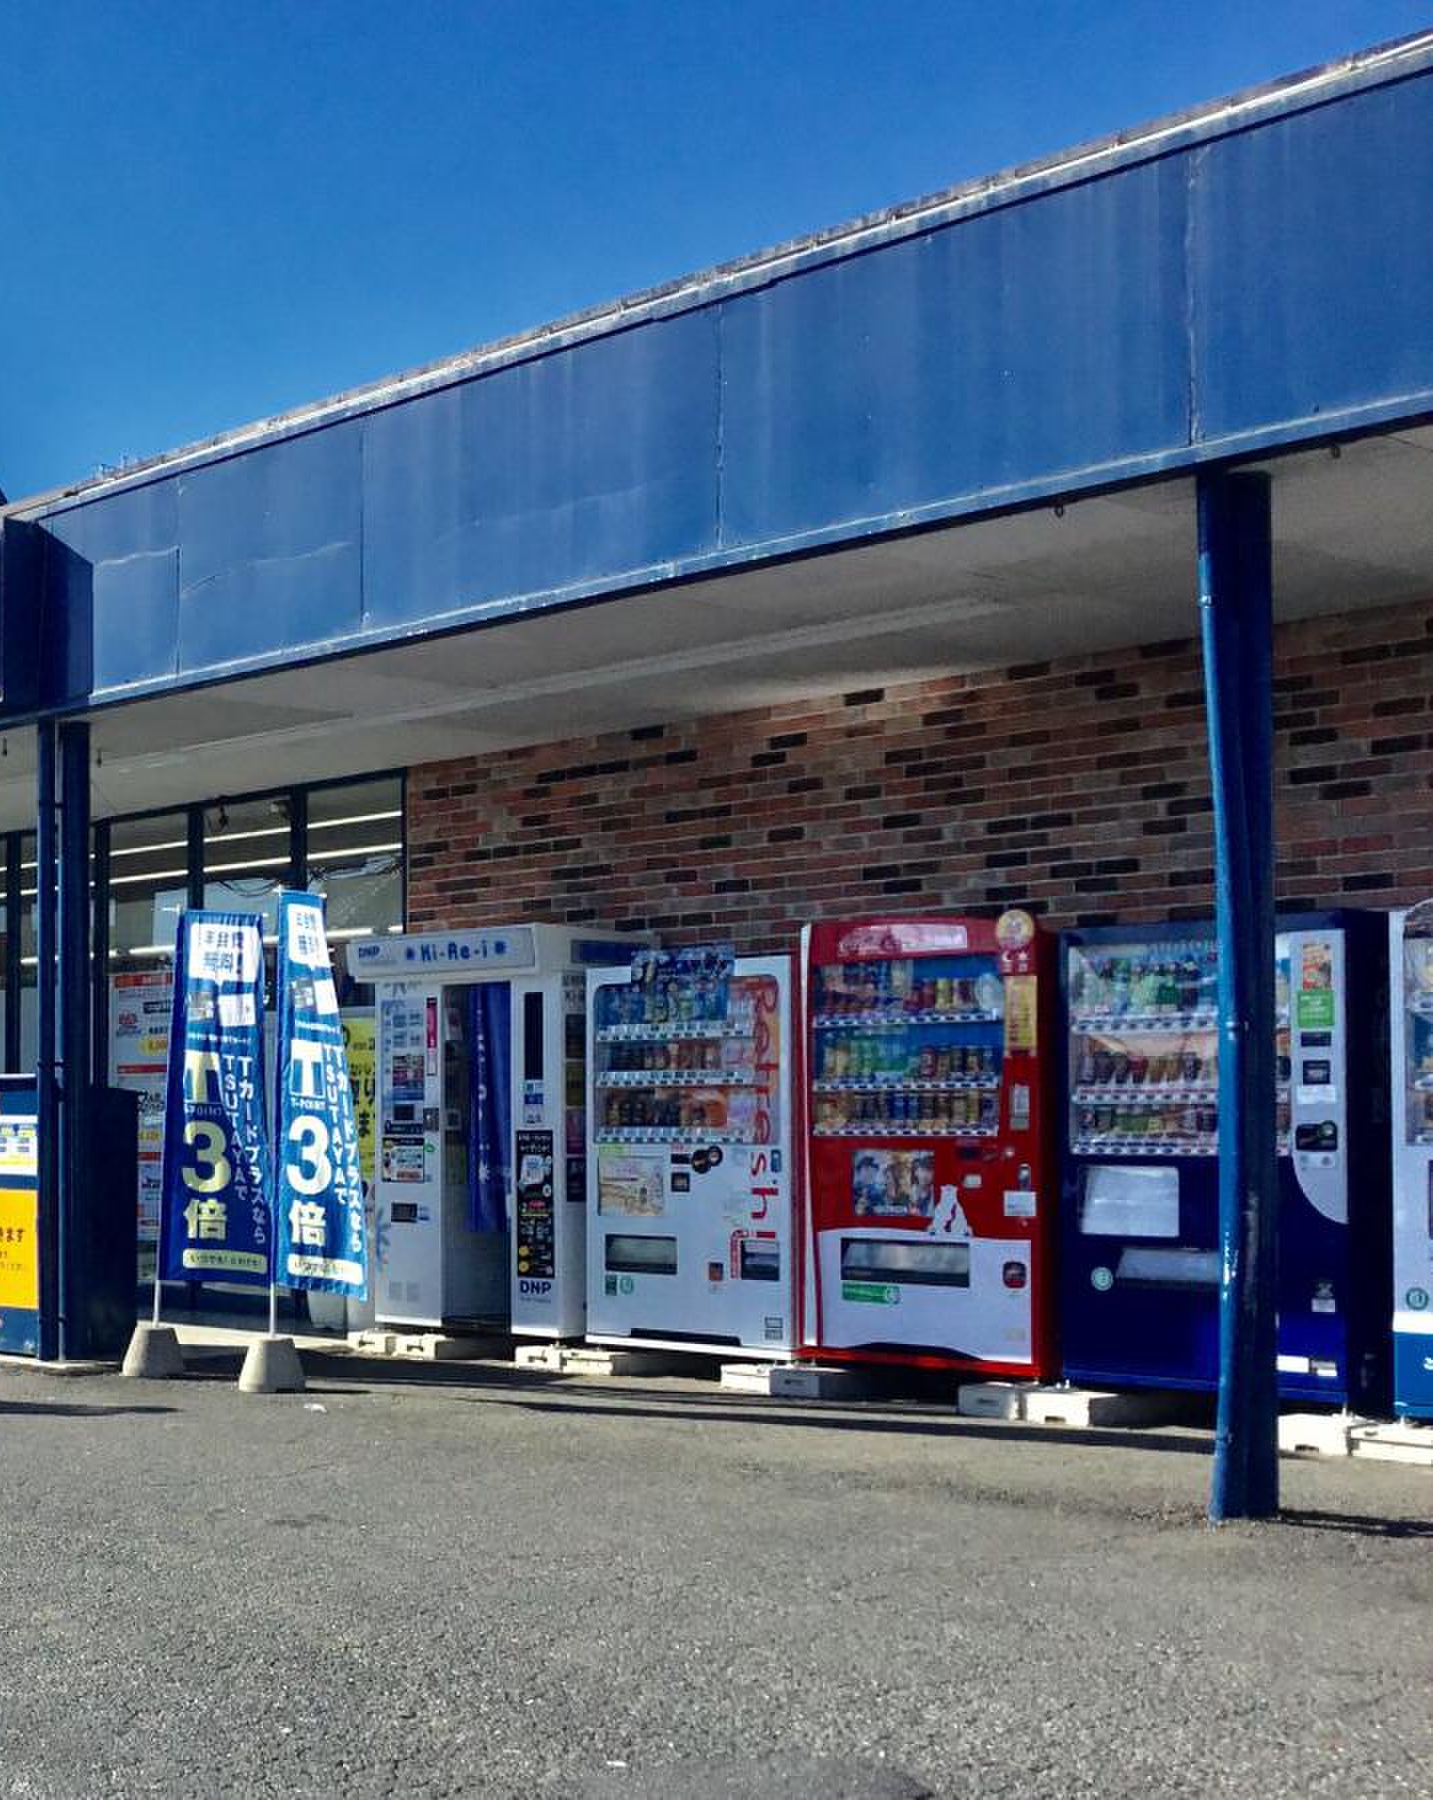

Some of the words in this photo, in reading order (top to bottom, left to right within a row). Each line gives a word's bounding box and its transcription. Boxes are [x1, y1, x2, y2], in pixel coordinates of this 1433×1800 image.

[223, 1056, 248, 1200] TSUTAYAで
[324, 1045, 347, 1205] TSUTAYAで
[520, 1280, 552, 1295] DNP
